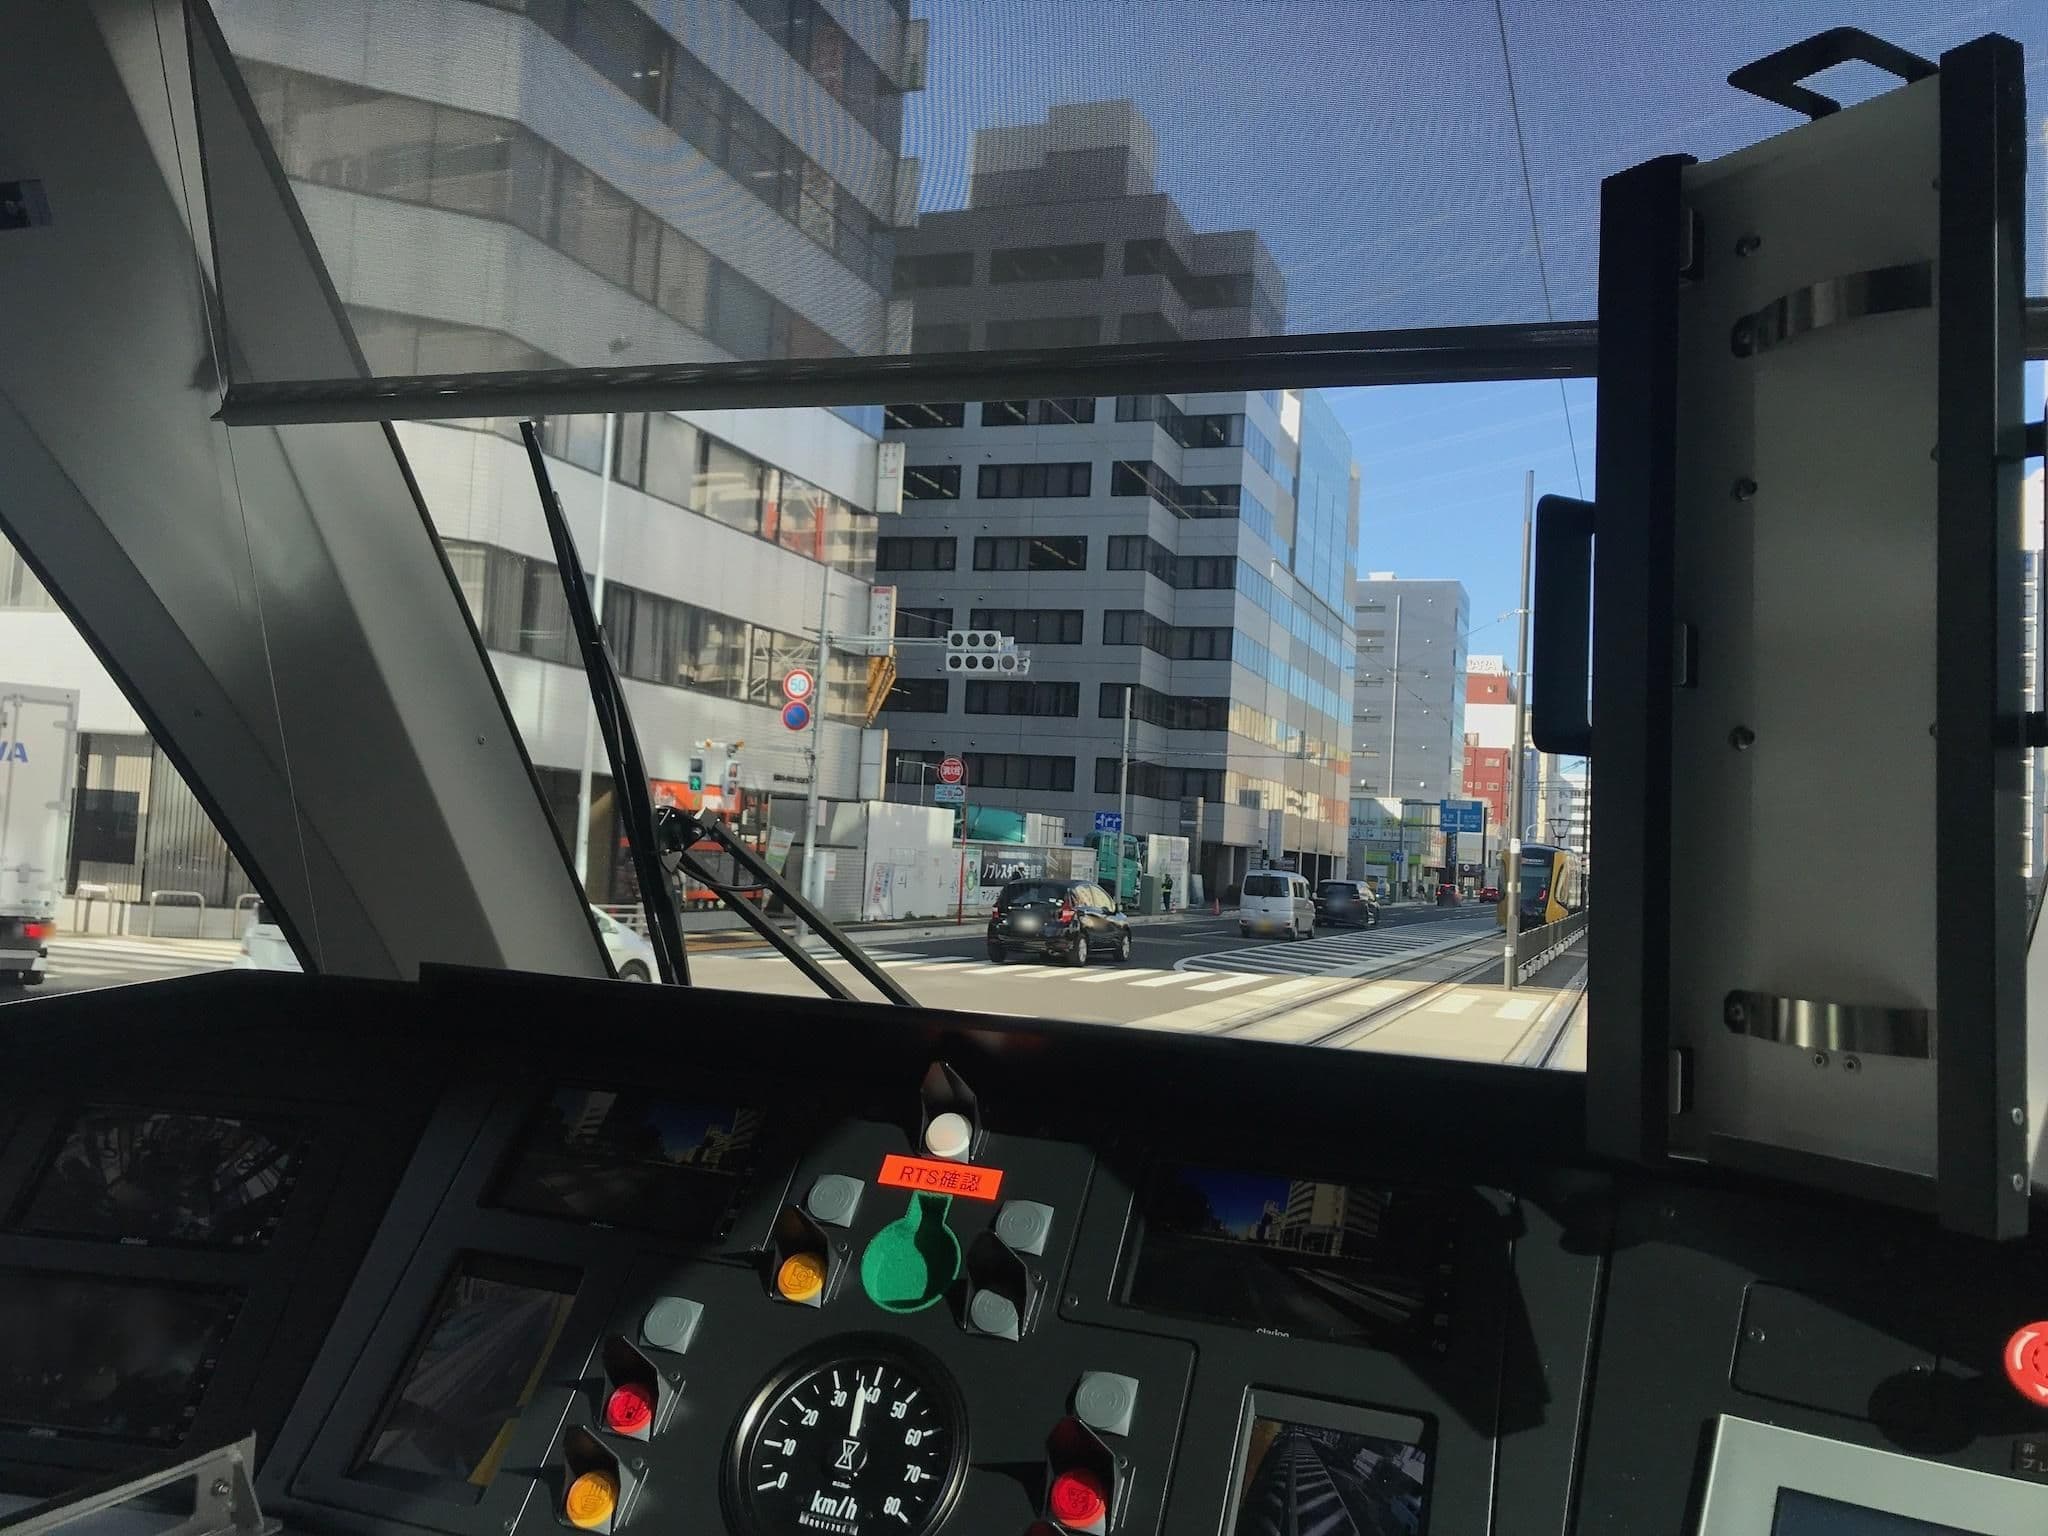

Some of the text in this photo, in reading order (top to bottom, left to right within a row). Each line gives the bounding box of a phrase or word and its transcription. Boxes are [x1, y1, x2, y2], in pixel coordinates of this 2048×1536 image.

[790, 677, 807, 692] 50
[900, 1166, 982, 1192] RTS確認
[830, 1390, 848, 1408] 30
[865, 1387, 881, 1404] 40
[801, 1409, 819, 1427] 20
[890, 1401, 908, 1419] 50
[904, 1428, 922, 1446] 60
[781, 1438, 797, 1456] 10
[776, 1471, 789, 1489] 0
[903, 1464, 922, 1484] 70
[810, 1489, 858, 1520] km/h
[883, 1496, 901, 1515] 80
